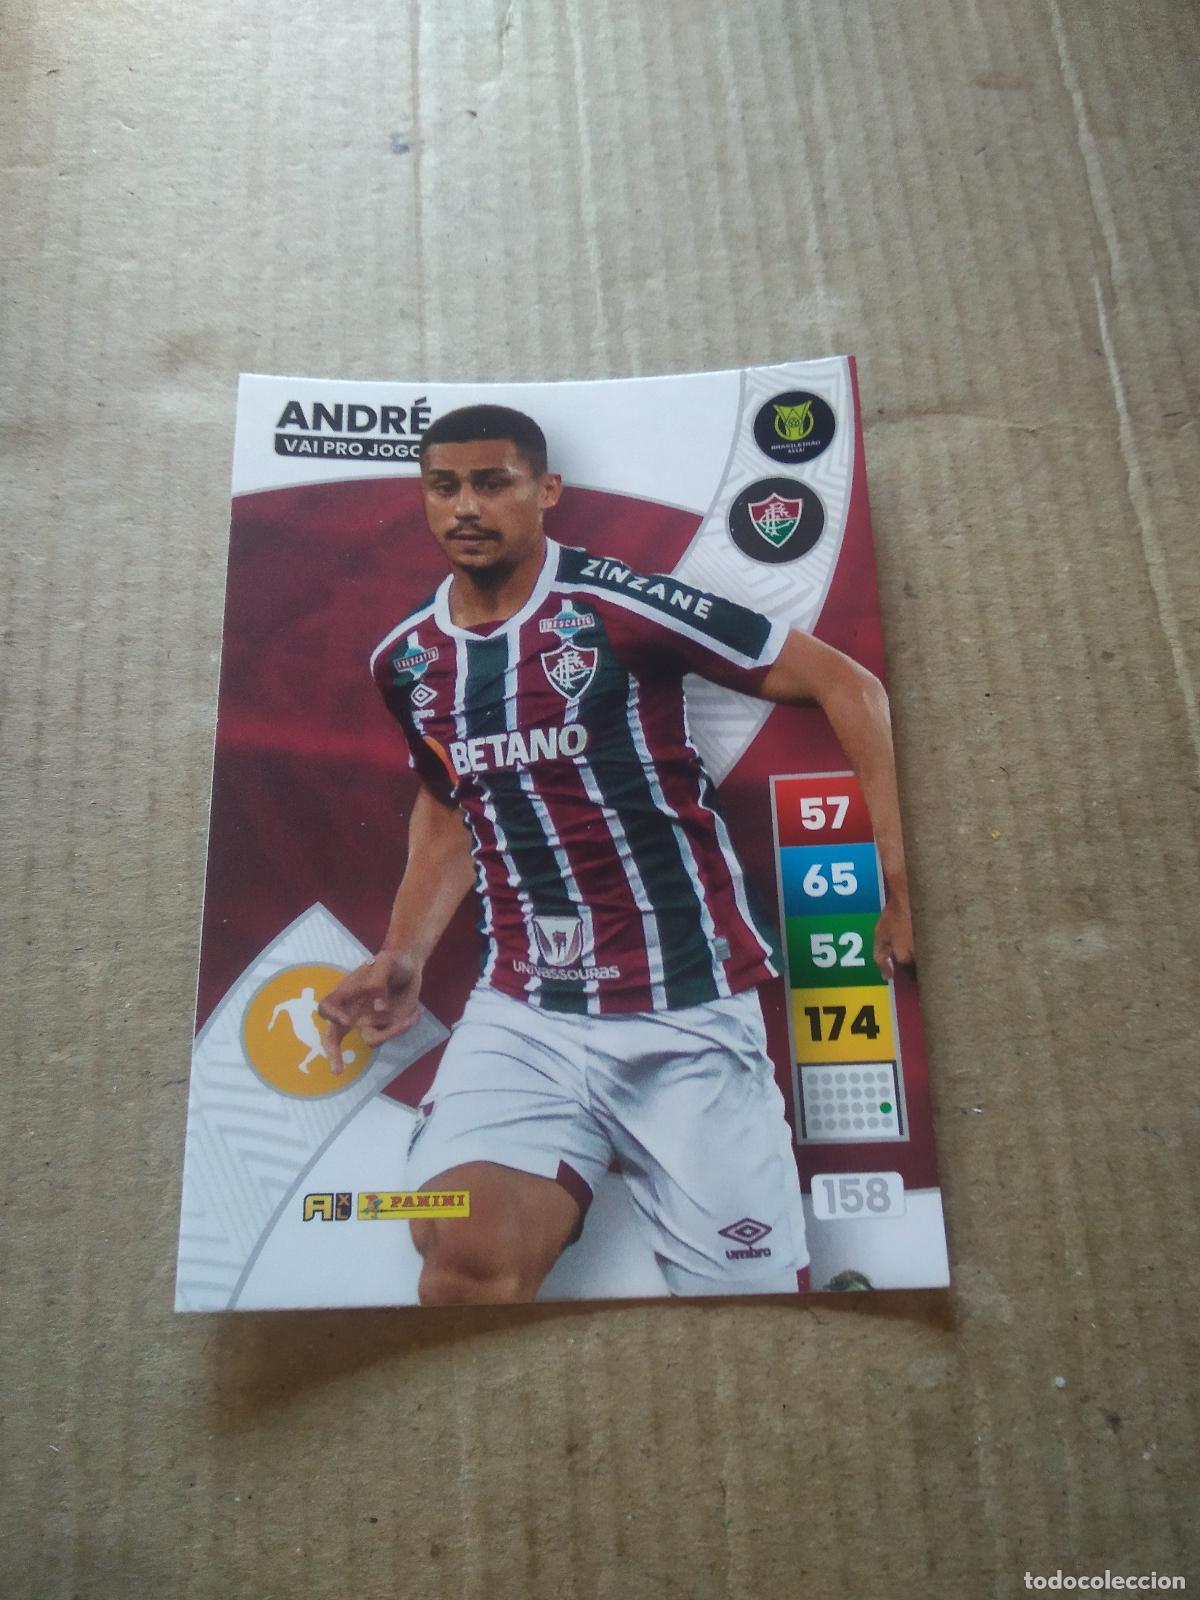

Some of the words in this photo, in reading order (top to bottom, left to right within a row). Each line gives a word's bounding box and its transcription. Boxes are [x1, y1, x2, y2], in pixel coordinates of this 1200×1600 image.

[276, 396, 432, 435] ANDRÉ
[284, 438, 318, 454] VAI
[323, 441, 364, 456] PRO
[580, 559, 713, 620] ZINZANE
[449, 723, 588, 776] BETANO
[800, 795, 850, 831] 57
[802, 862, 858, 897] 65
[810, 932, 866, 969] 52
[804, 1005, 880, 1042] 174
[390, 1194, 466, 1208] PANINI
[822, 1177, 892, 1215] 158
